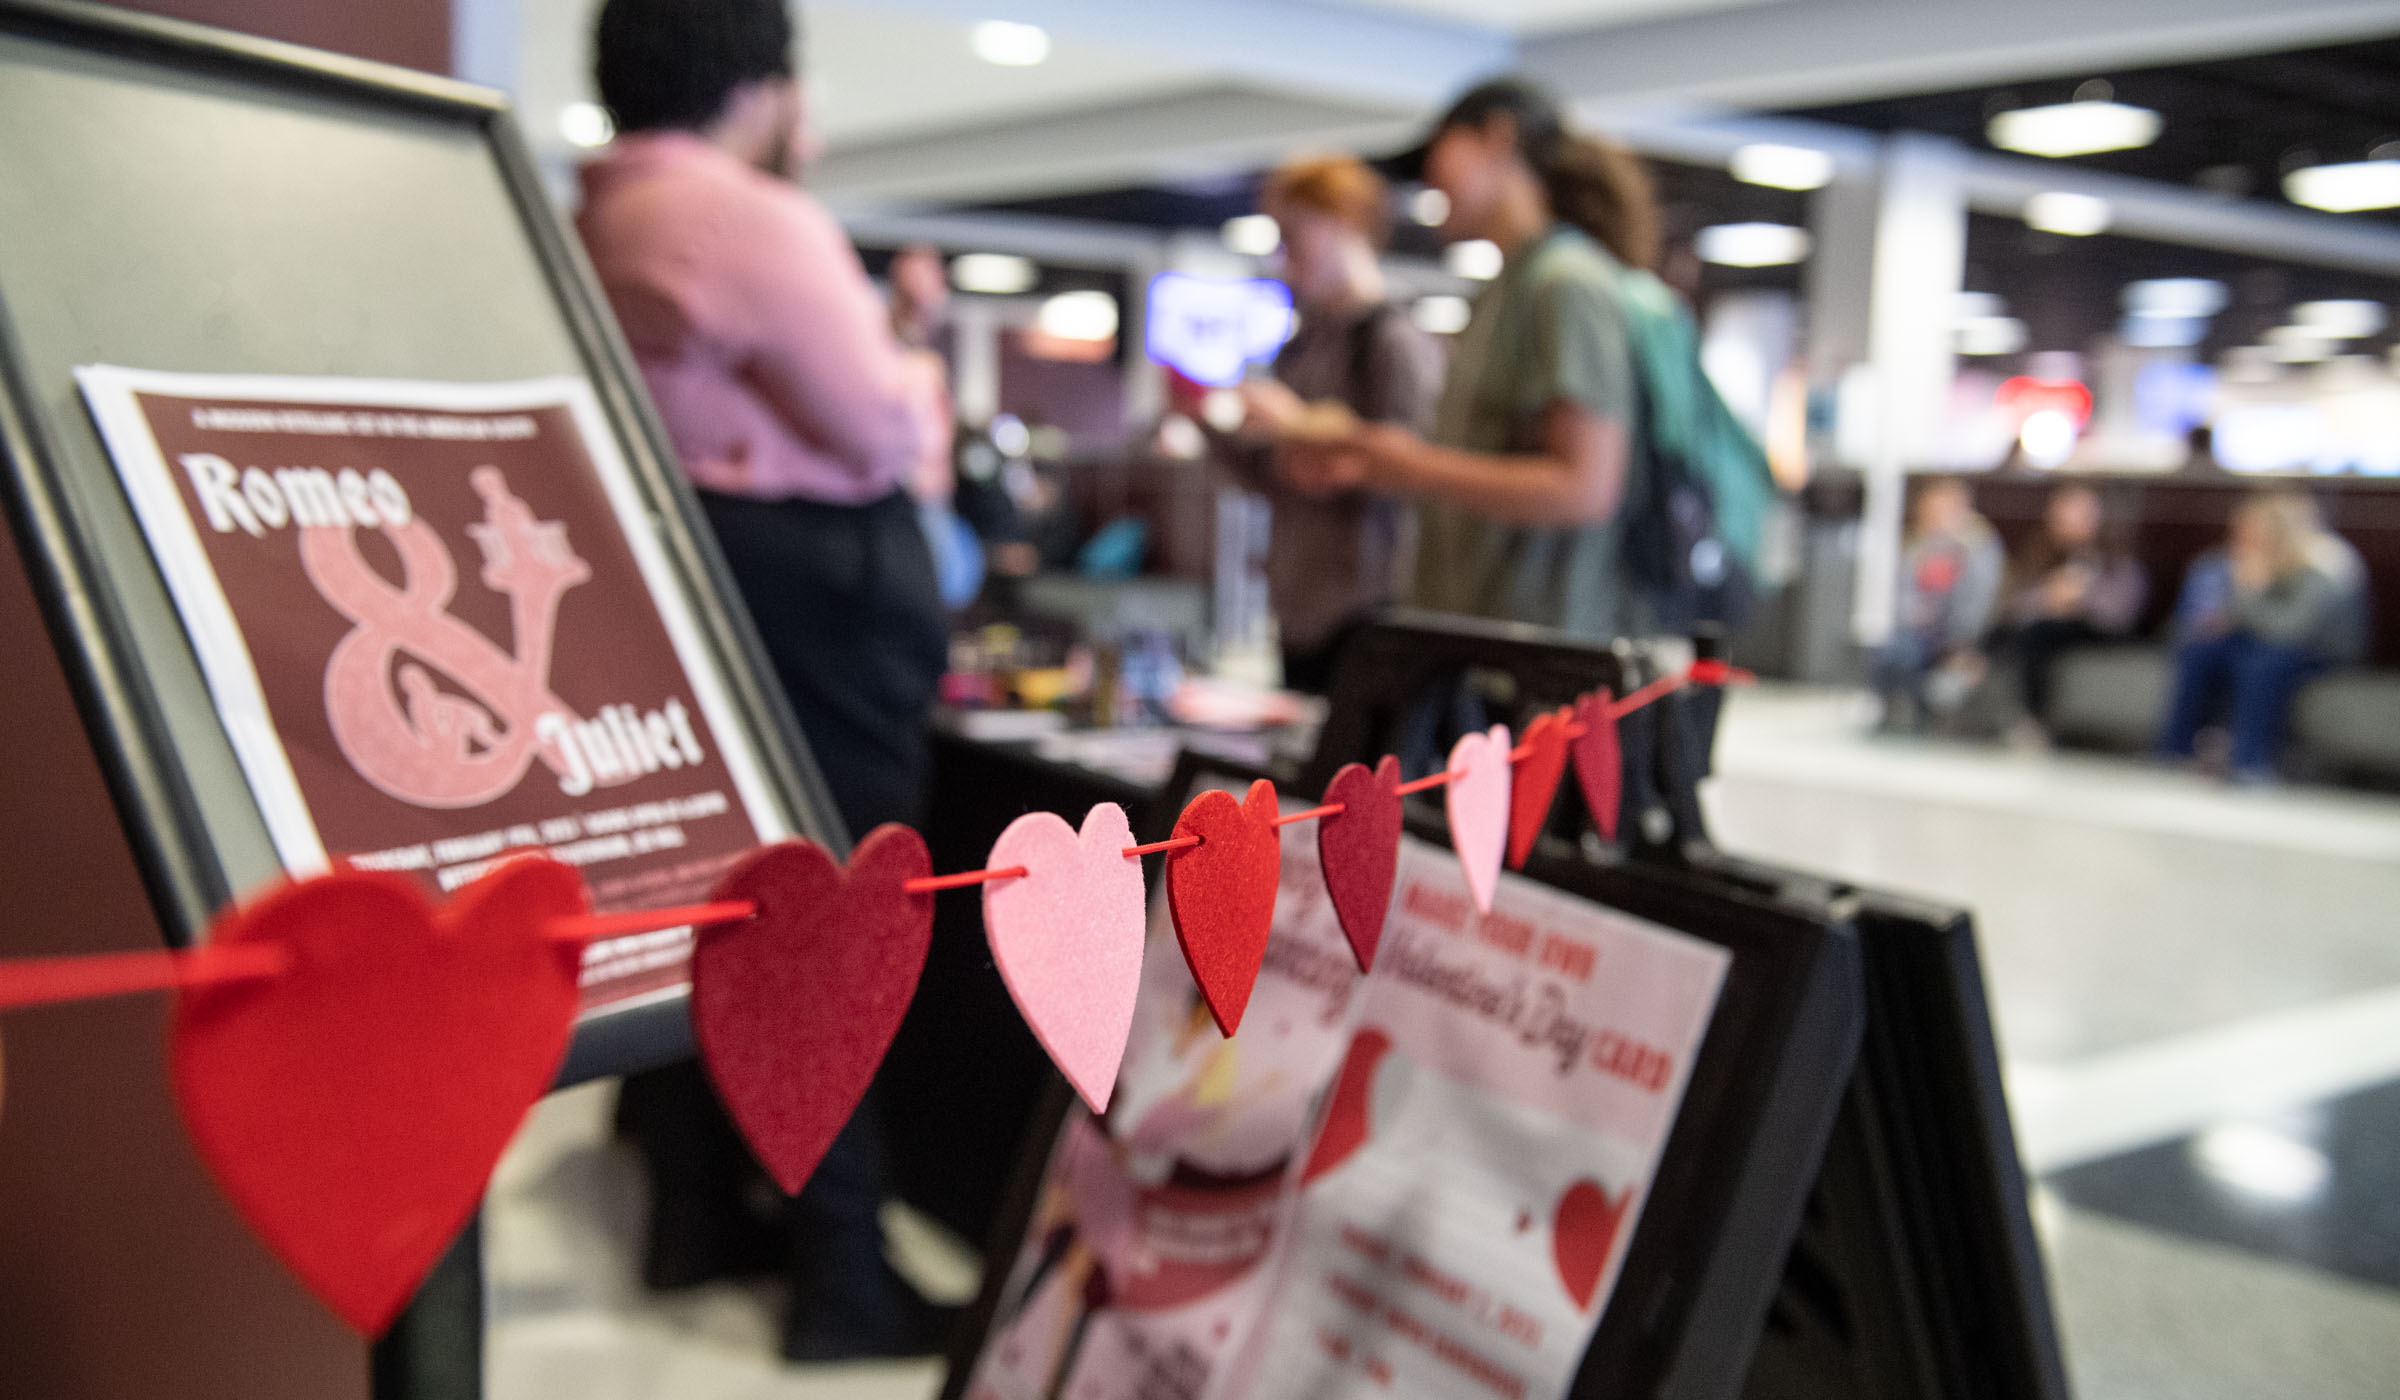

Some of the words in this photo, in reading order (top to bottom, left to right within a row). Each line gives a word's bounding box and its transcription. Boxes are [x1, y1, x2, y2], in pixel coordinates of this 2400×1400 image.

[180, 452, 412, 538] Romeo
[535, 698, 703, 796] Juliet
[1541, 931, 1597, 980] OWN
[1519, 982, 1588, 1076] Day
[1590, 1030, 1673, 1094] CARD
